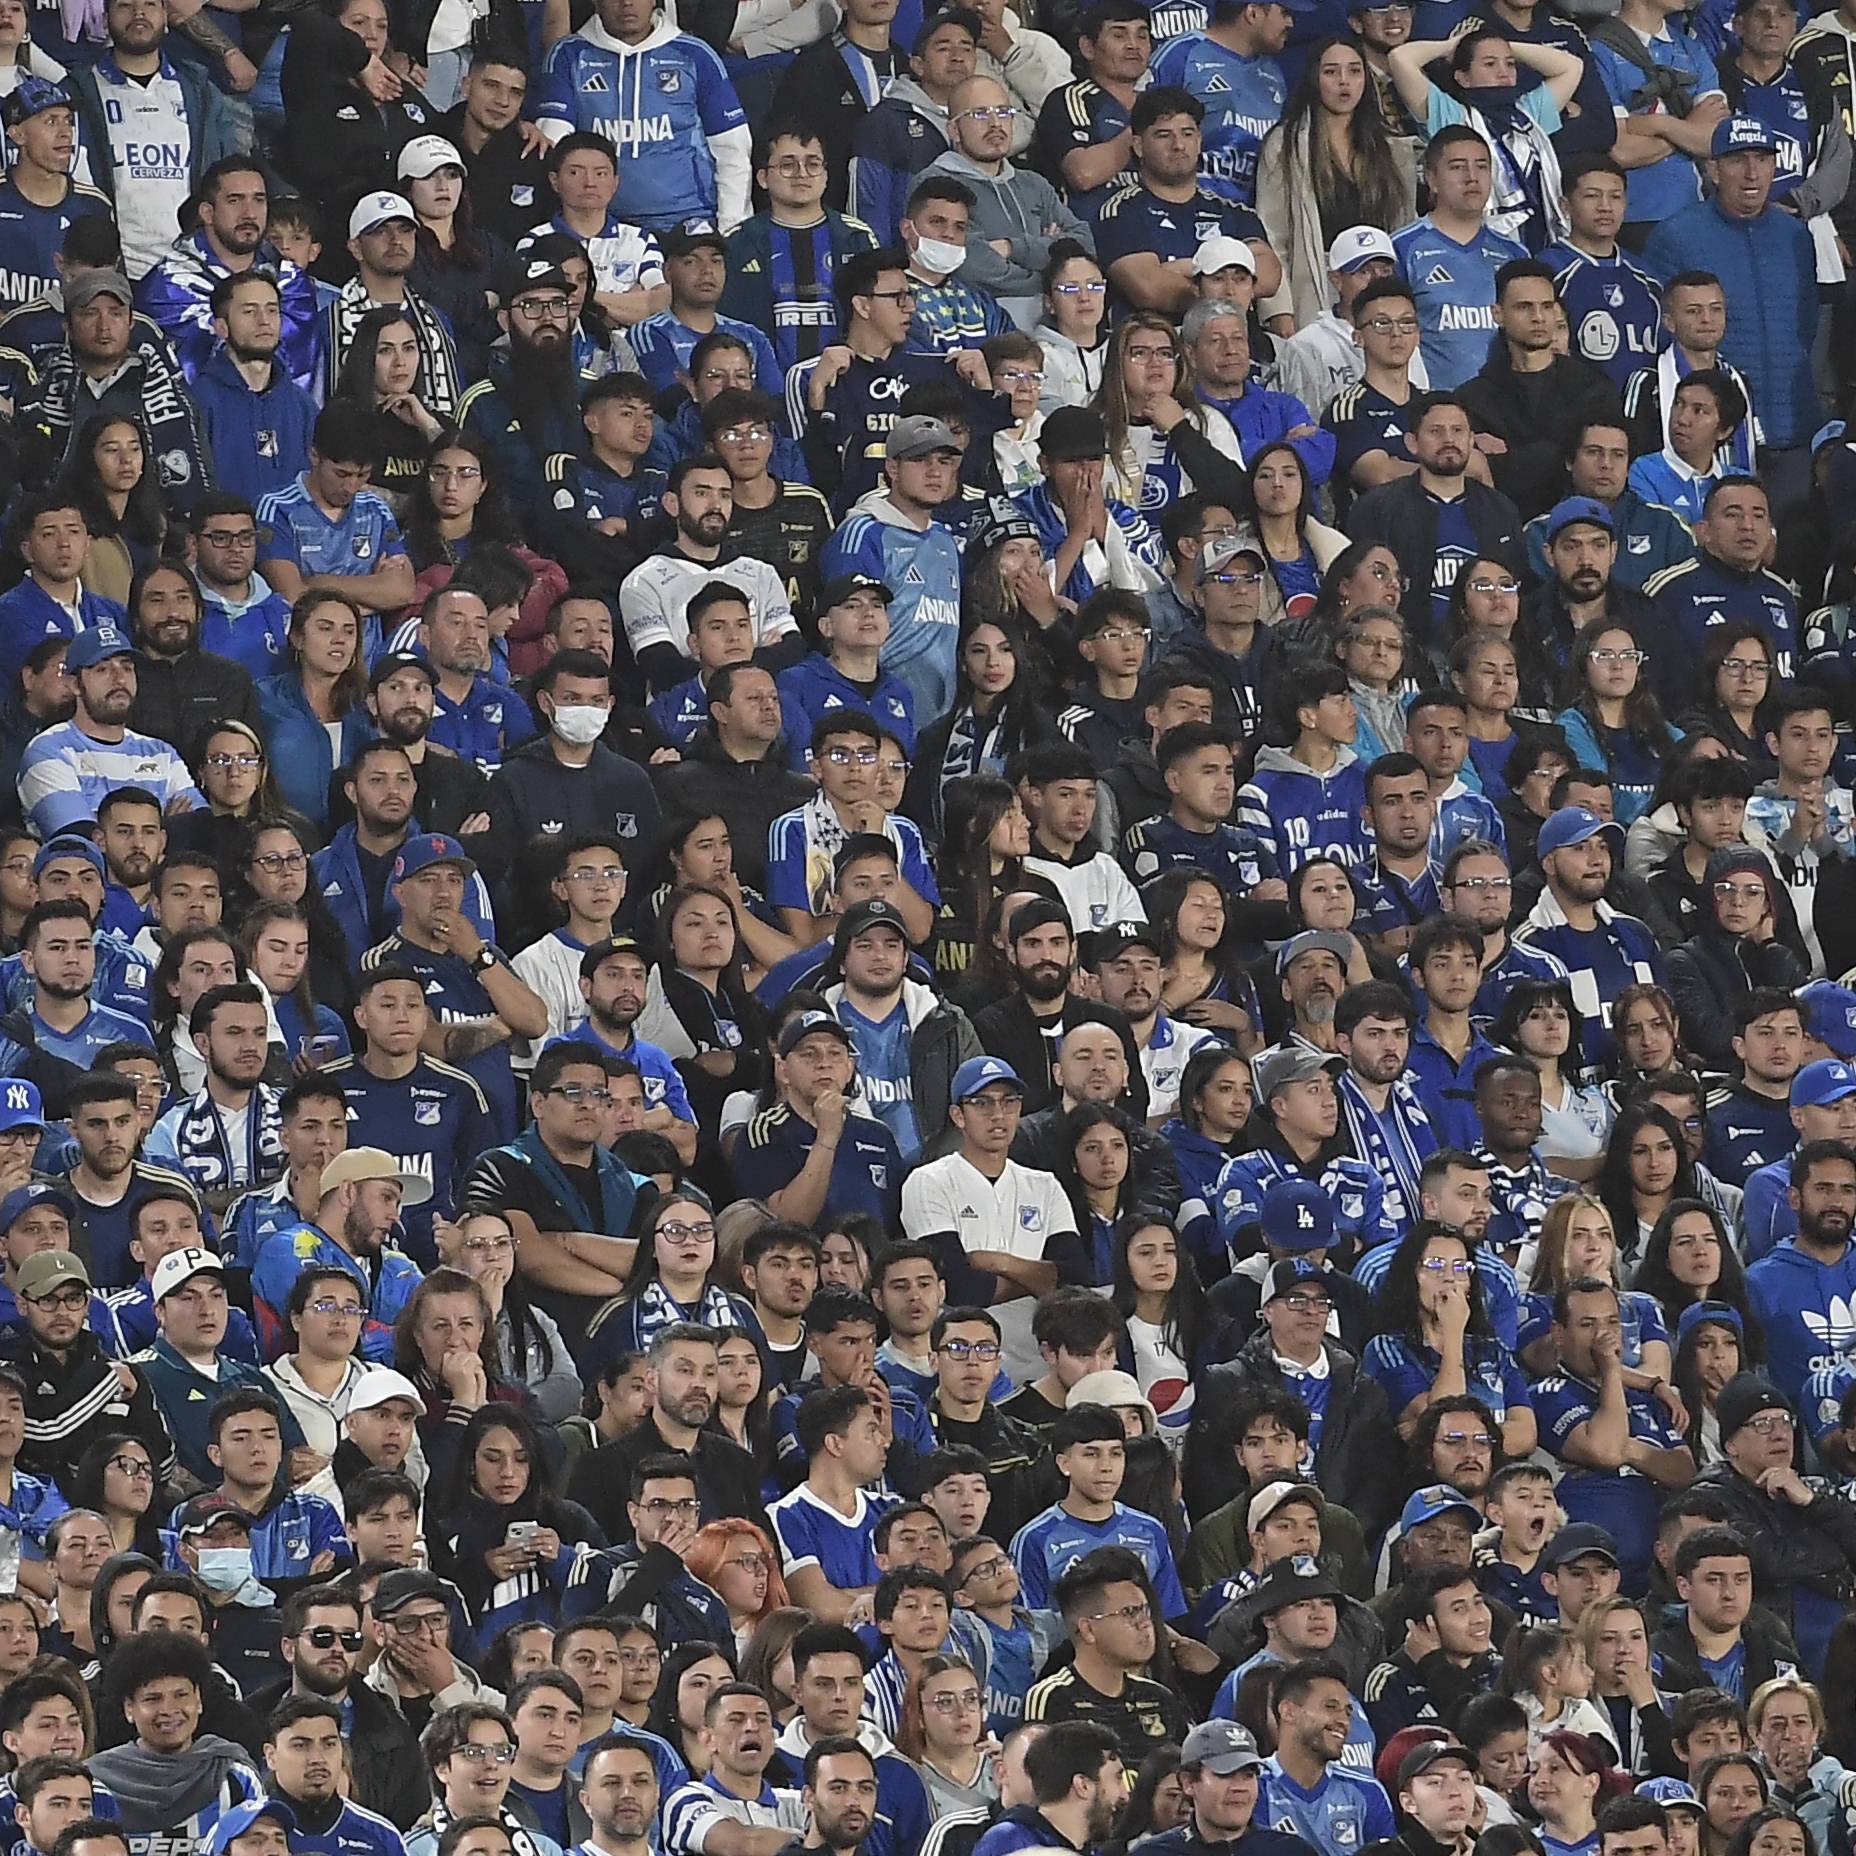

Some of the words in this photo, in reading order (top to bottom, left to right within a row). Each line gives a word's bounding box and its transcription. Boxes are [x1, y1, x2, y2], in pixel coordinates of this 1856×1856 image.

[592, 115, 675, 144] ANDINA
[130, 167, 183, 179] CERVEZA
[1283, 817, 1310, 849] 10
[7, 1084, 30, 1109] NY
[1297, 1204, 1314, 1228] LA
[183, 1248, 203, 1269] P
[128, 1835, 206, 1856] PEPS
